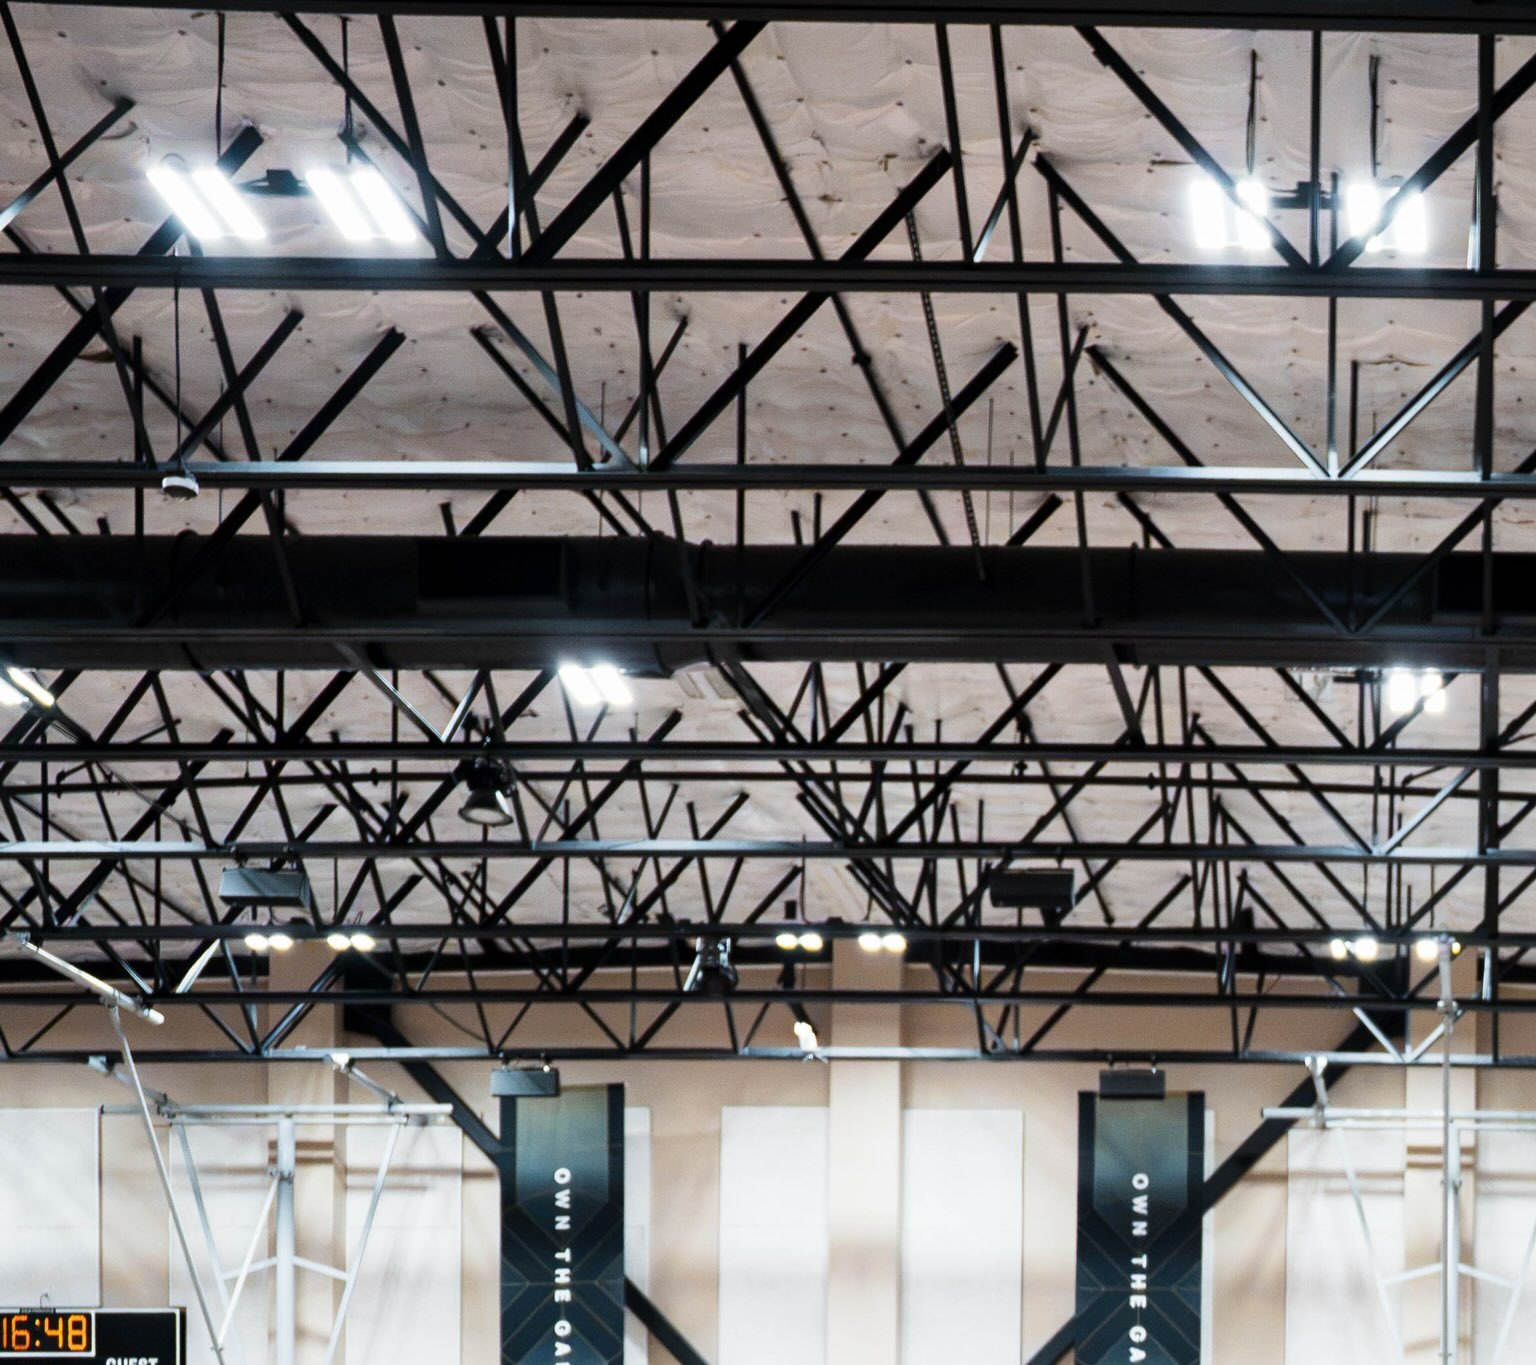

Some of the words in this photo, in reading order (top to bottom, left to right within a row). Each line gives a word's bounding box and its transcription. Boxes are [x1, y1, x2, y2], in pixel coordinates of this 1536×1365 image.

[554, 1167, 572, 1230] OWN
[1131, 1173, 1150, 1237] OWN
[554, 1248, 572, 1303] THE
[1129, 1254, 1148, 1309] THE
[2, 1314, 87, 1351] 16:48
